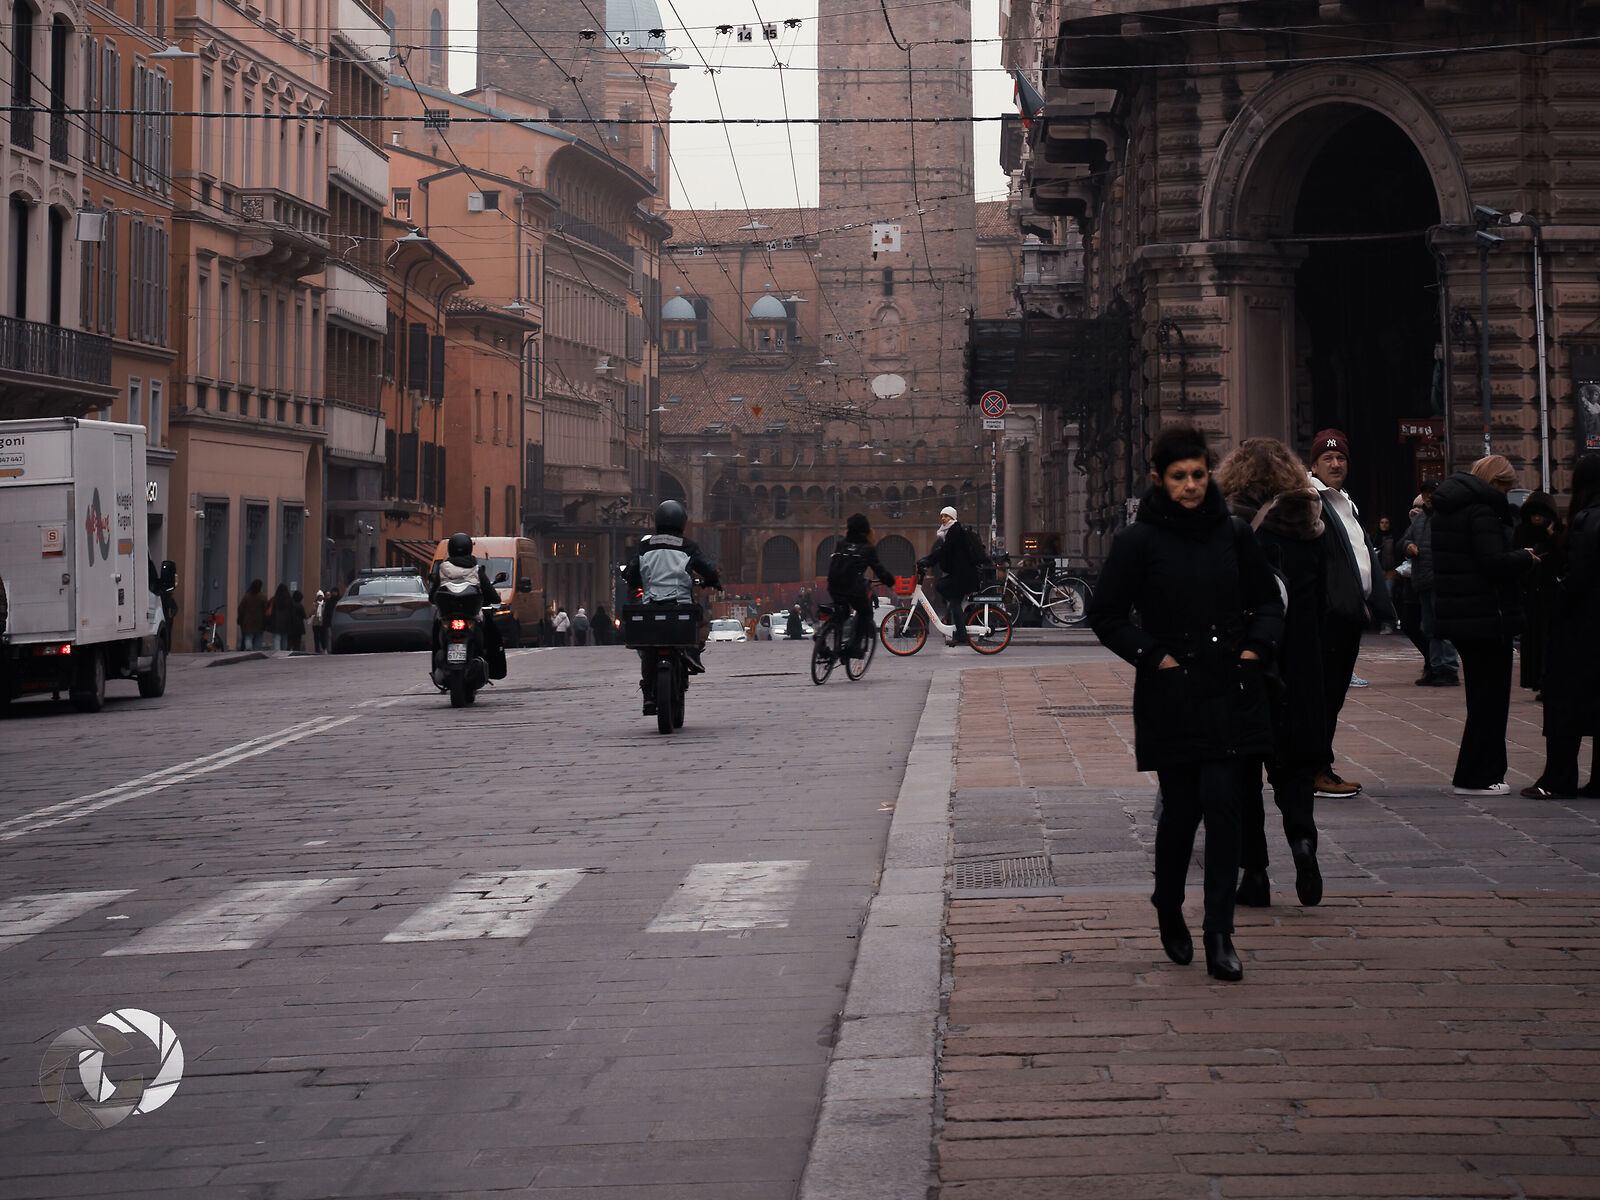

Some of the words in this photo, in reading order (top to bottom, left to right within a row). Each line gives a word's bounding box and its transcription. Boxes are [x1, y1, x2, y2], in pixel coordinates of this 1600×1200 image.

[737, 31, 752, 41] 14
[765, 29, 778, 39] 15
[615, 36, 630, 45] 13
[49, 532, 56, 540] S
